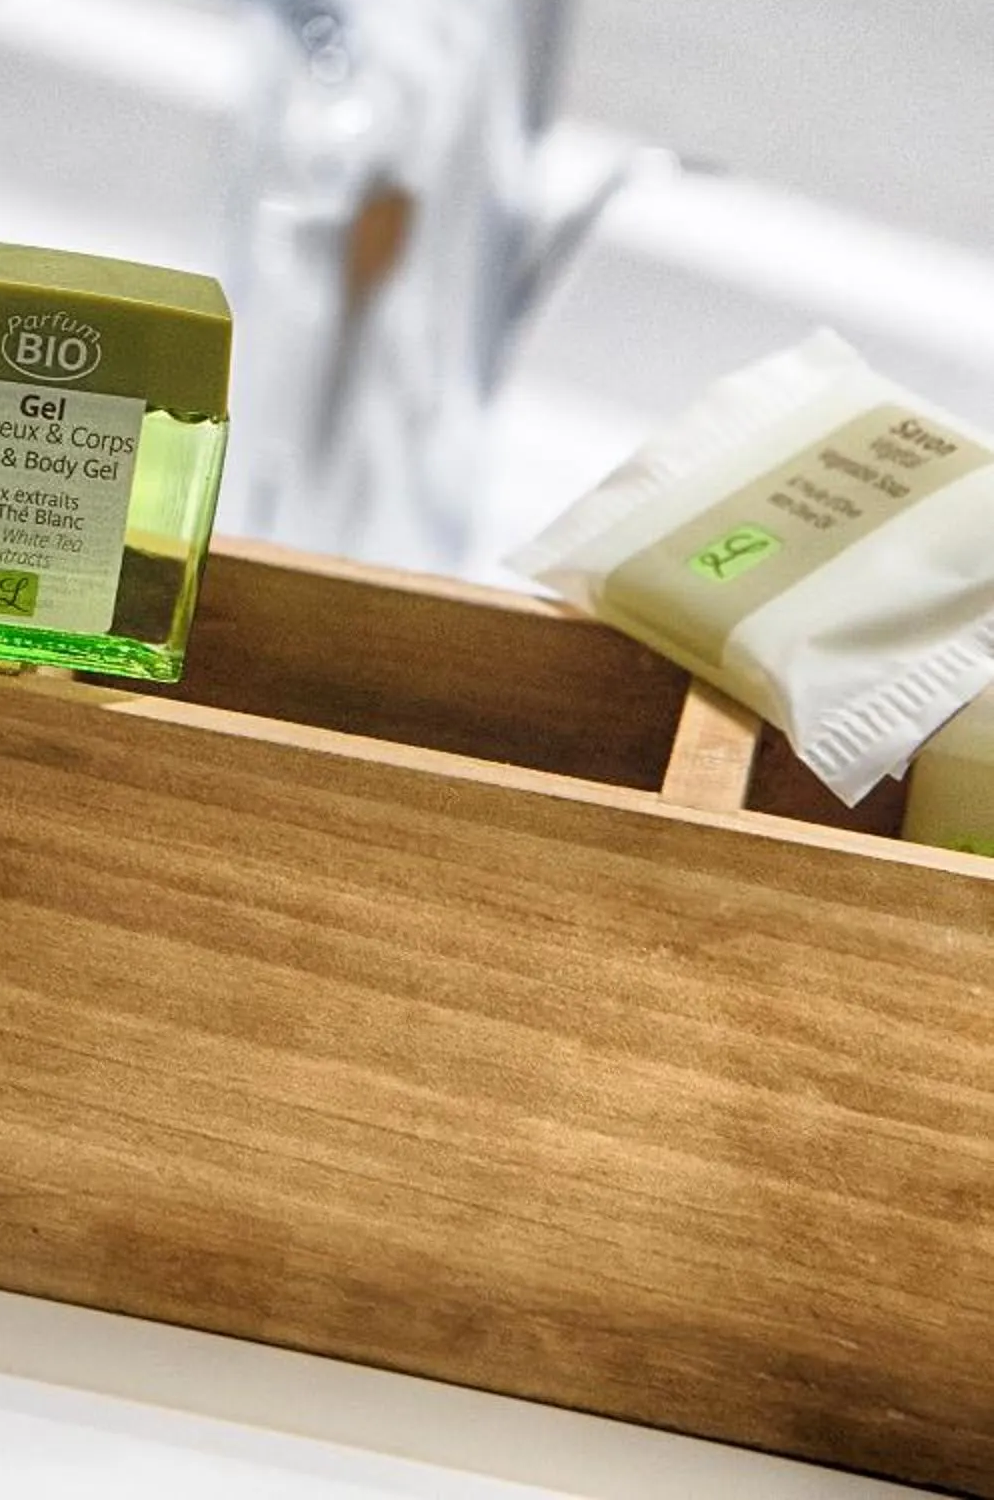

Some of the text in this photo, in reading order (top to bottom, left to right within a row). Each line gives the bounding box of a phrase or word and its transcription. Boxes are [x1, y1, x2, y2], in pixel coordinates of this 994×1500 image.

[15, 331, 88, 371] BIO
[20, 394, 66, 421] Gel
[45, 423, 63, 445] &
[71, 426, 135, 456] Corps
[1, 447, 17, 468] &
[24, 450, 78, 480] Body
[83, 459, 118, 481] Gel
[14, 489, 79, 511] extraits
[35, 508, 85, 531] Blanc
[2, 527, 50, 549] White
[54, 534, 83, 553] Tea
